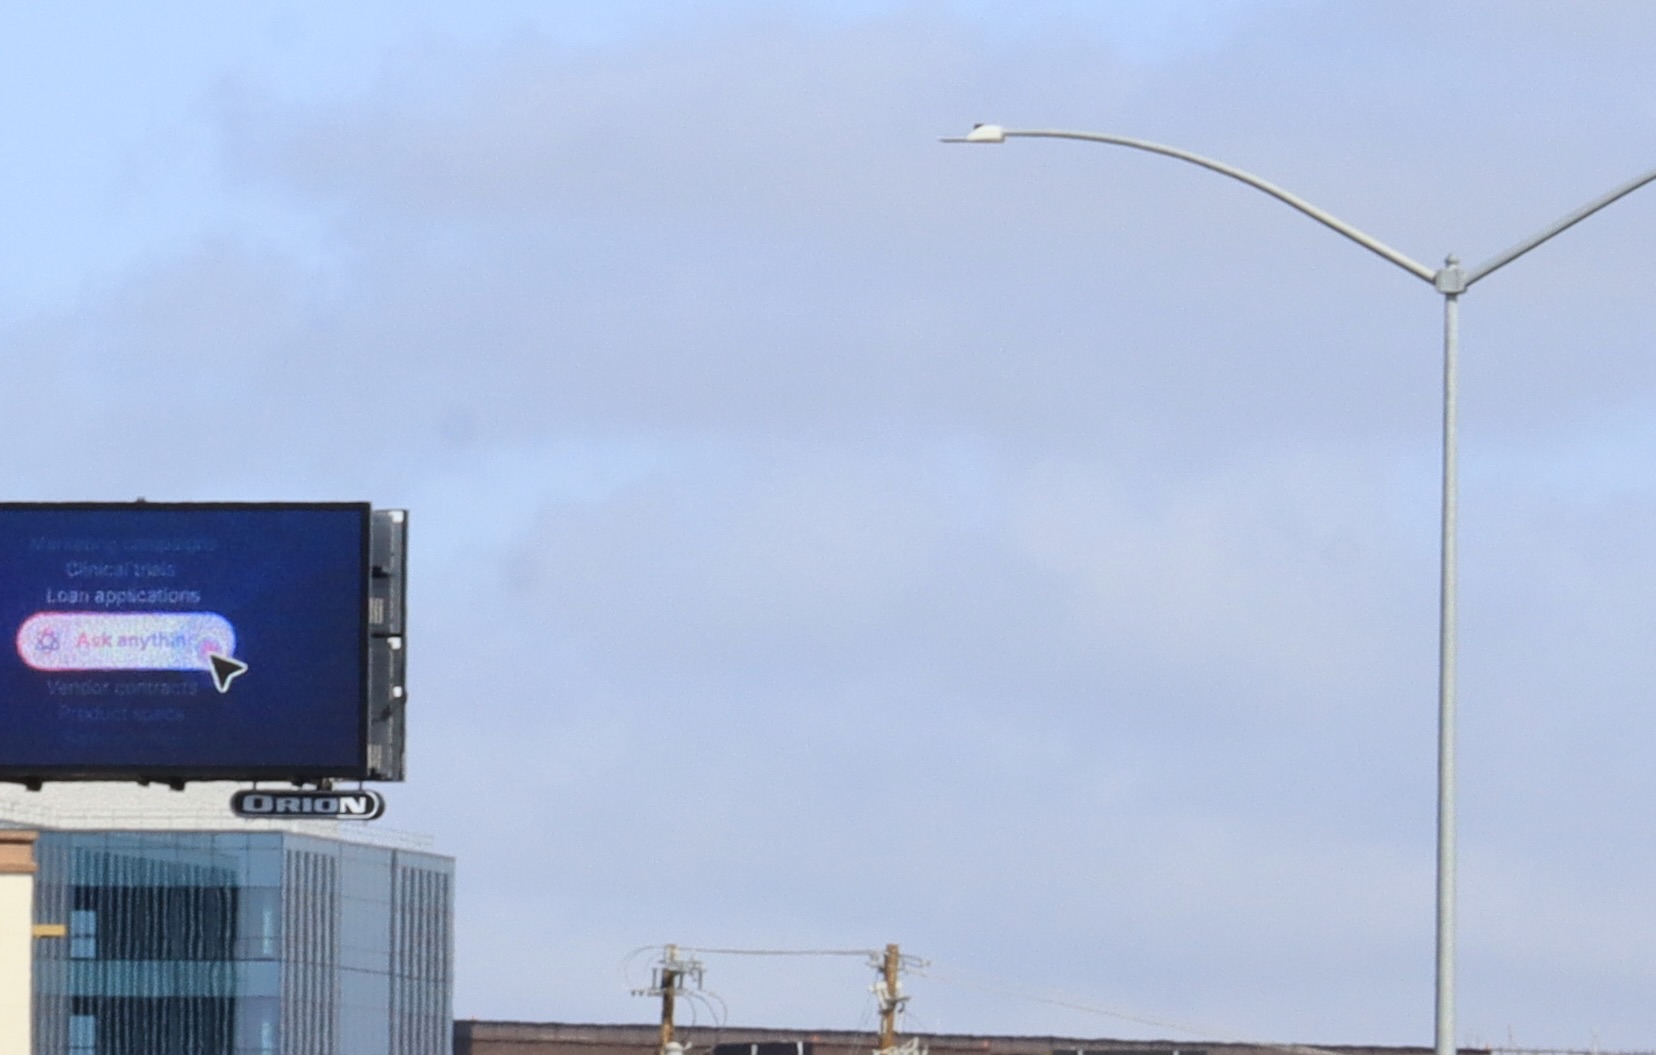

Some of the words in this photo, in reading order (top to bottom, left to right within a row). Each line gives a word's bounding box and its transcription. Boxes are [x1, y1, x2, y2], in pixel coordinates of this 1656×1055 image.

[46, 587, 90, 604] Loan
[94, 587, 201, 607] applications
[75, 631, 113, 649] Ask
[242, 794, 367, 814] ORION
